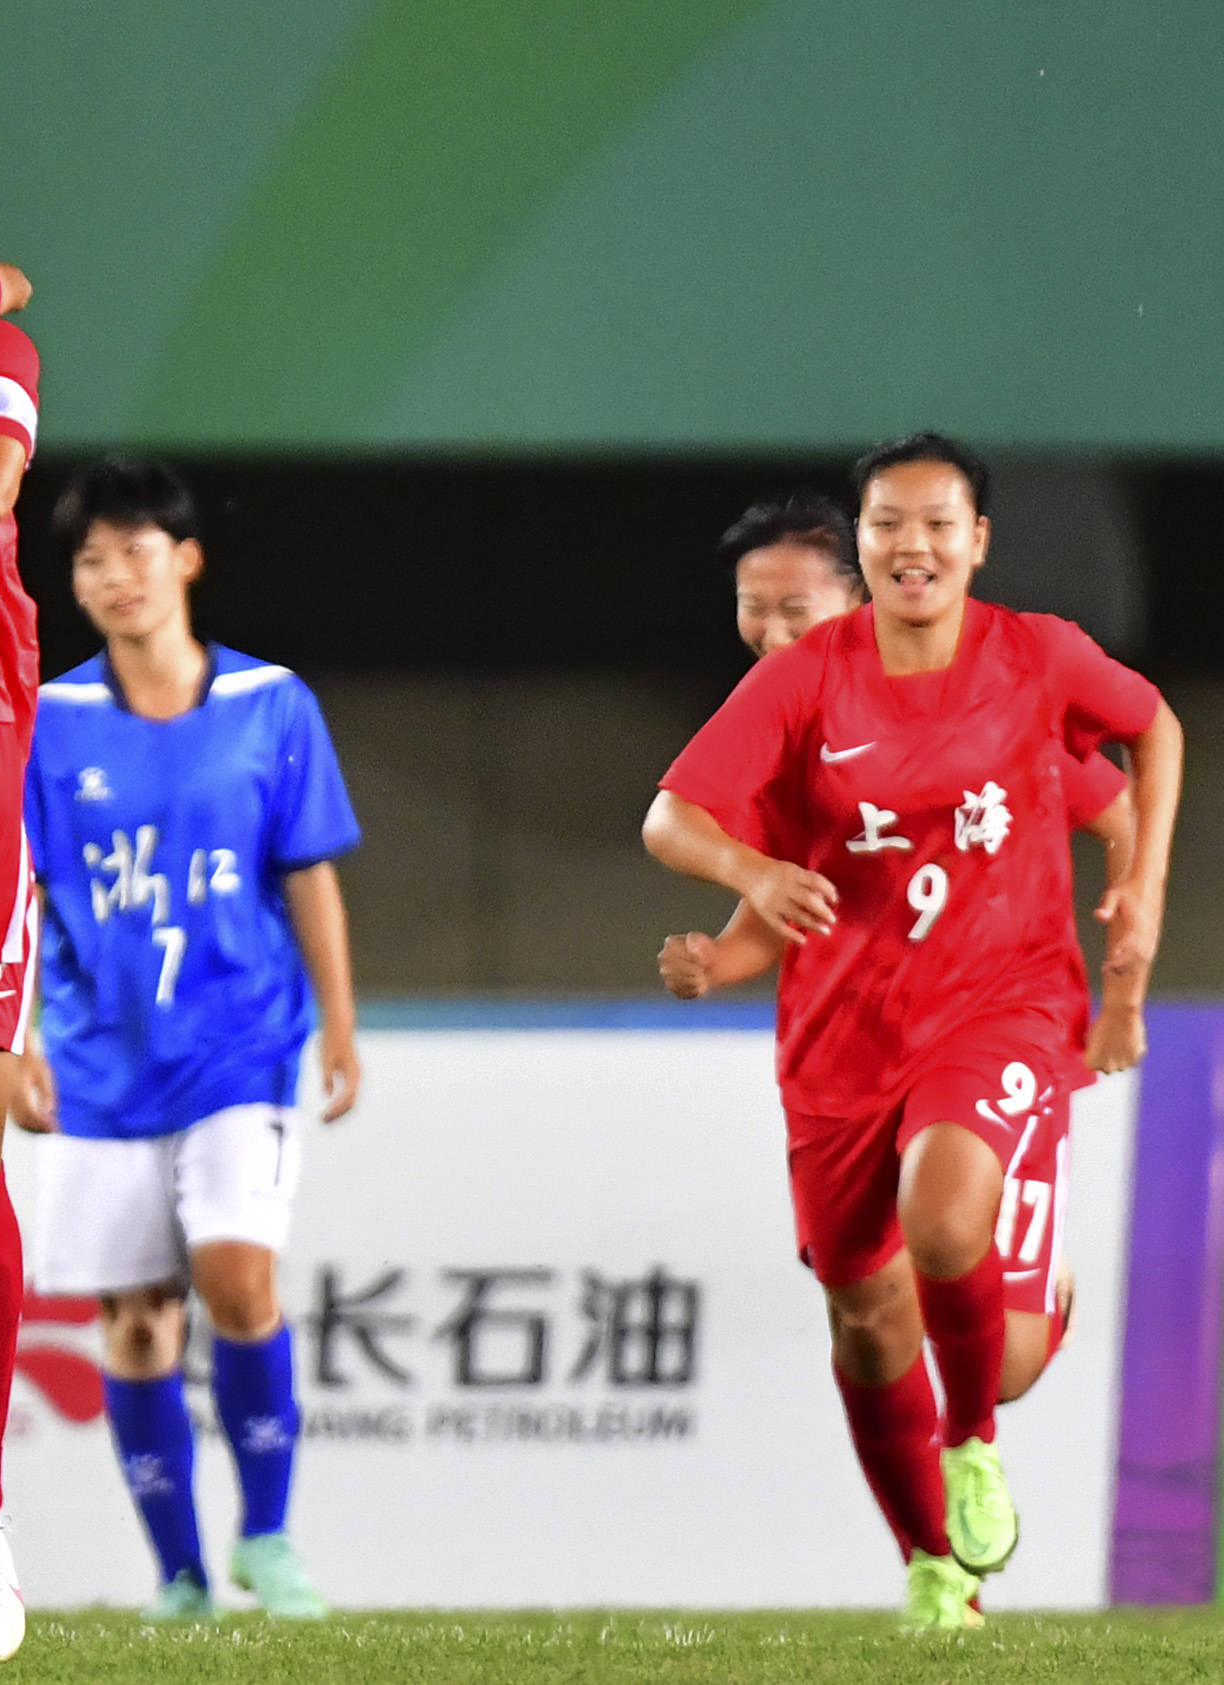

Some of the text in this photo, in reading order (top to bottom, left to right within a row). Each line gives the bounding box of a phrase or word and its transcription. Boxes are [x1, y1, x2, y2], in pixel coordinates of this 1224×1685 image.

[845, 780, 1013, 854] 上海
[907, 863, 948, 942] 9
[152, 926, 187, 1006] 7
[997, 1061, 1037, 1115] 9
[994, 1176, 1051, 1262] 17
[186, 1263, 698, 1390] 长石油
